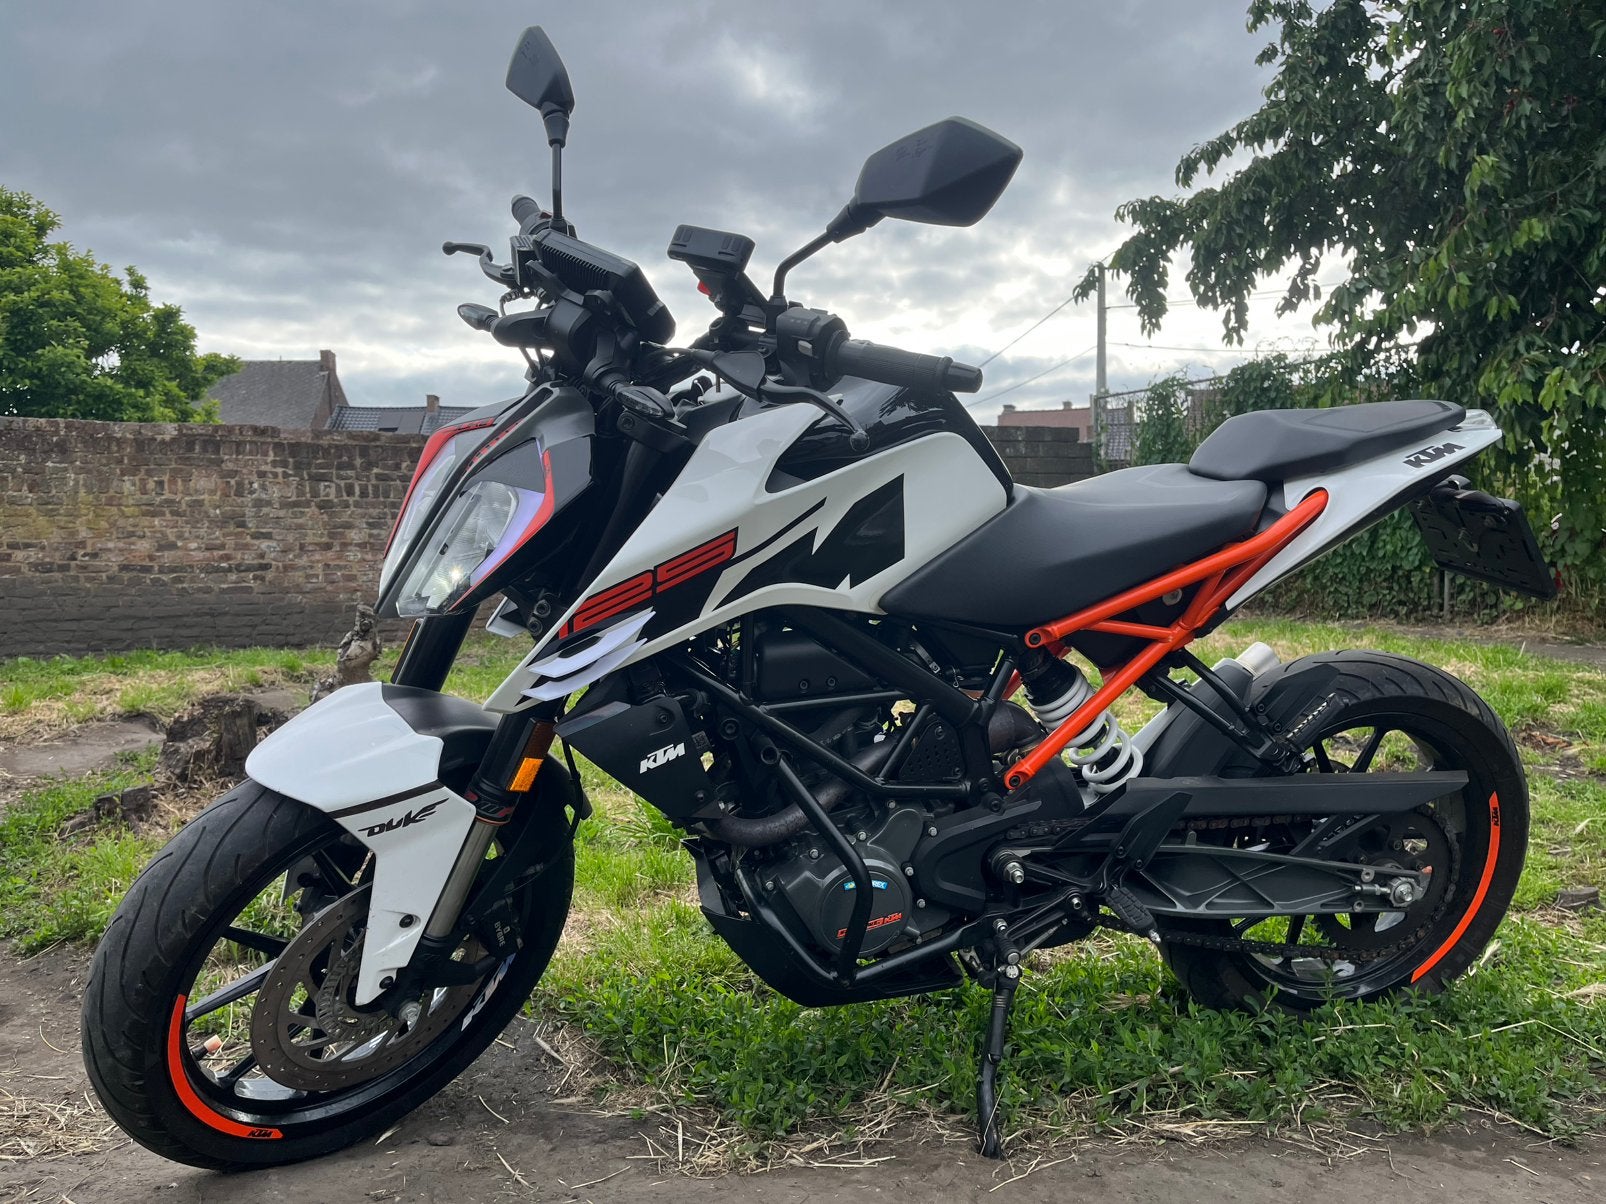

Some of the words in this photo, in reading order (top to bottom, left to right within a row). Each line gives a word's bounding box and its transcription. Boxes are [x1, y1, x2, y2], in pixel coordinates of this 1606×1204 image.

[1403, 442, 1466, 468] KTM
[558, 527, 738, 640] 125
[639, 742, 686, 774] KTM
[357, 797, 450, 837] DUKE
[248, 1129, 273, 1138] KTM
